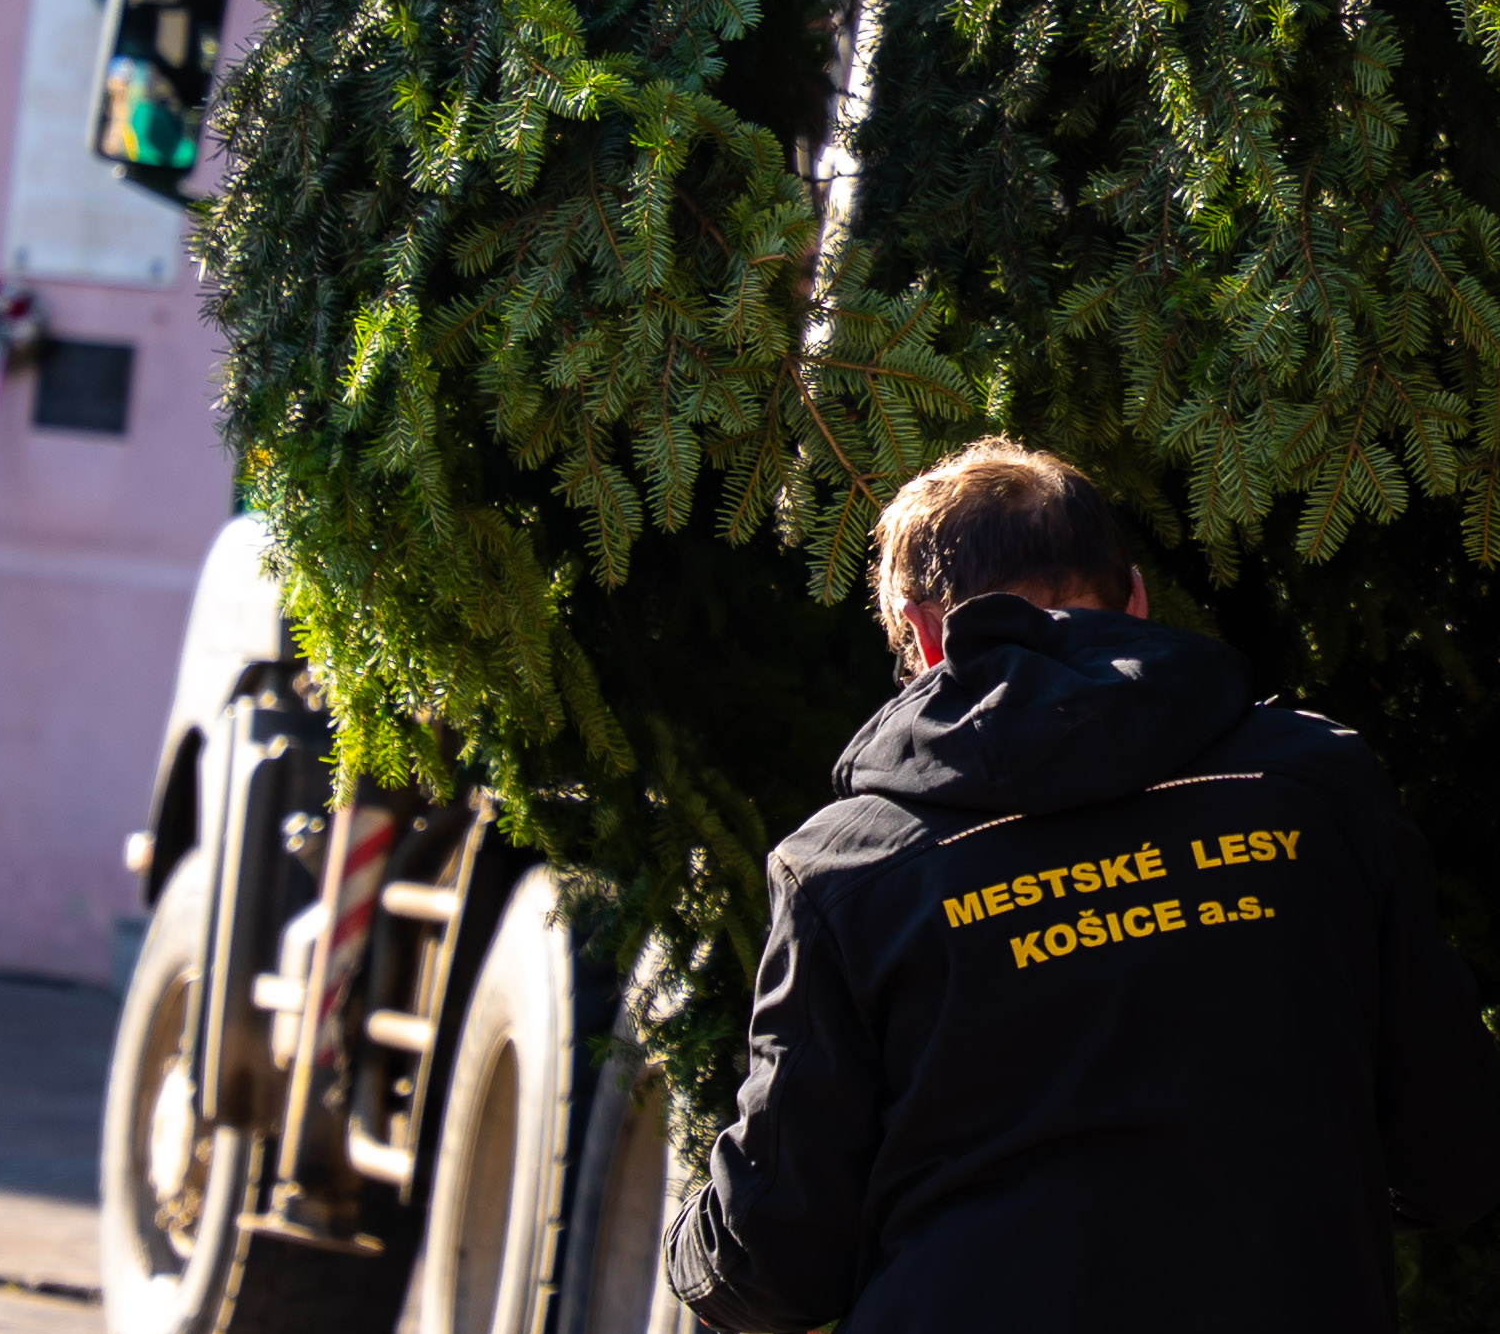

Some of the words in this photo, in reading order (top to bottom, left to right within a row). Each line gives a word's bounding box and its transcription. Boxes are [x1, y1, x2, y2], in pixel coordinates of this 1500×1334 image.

[942, 842, 1167, 927] MESTSKÉ
[1190, 830, 1301, 869] LESY
[1009, 899, 1187, 969] KOŠICE
[1197, 895, 1275, 926] a.s.
